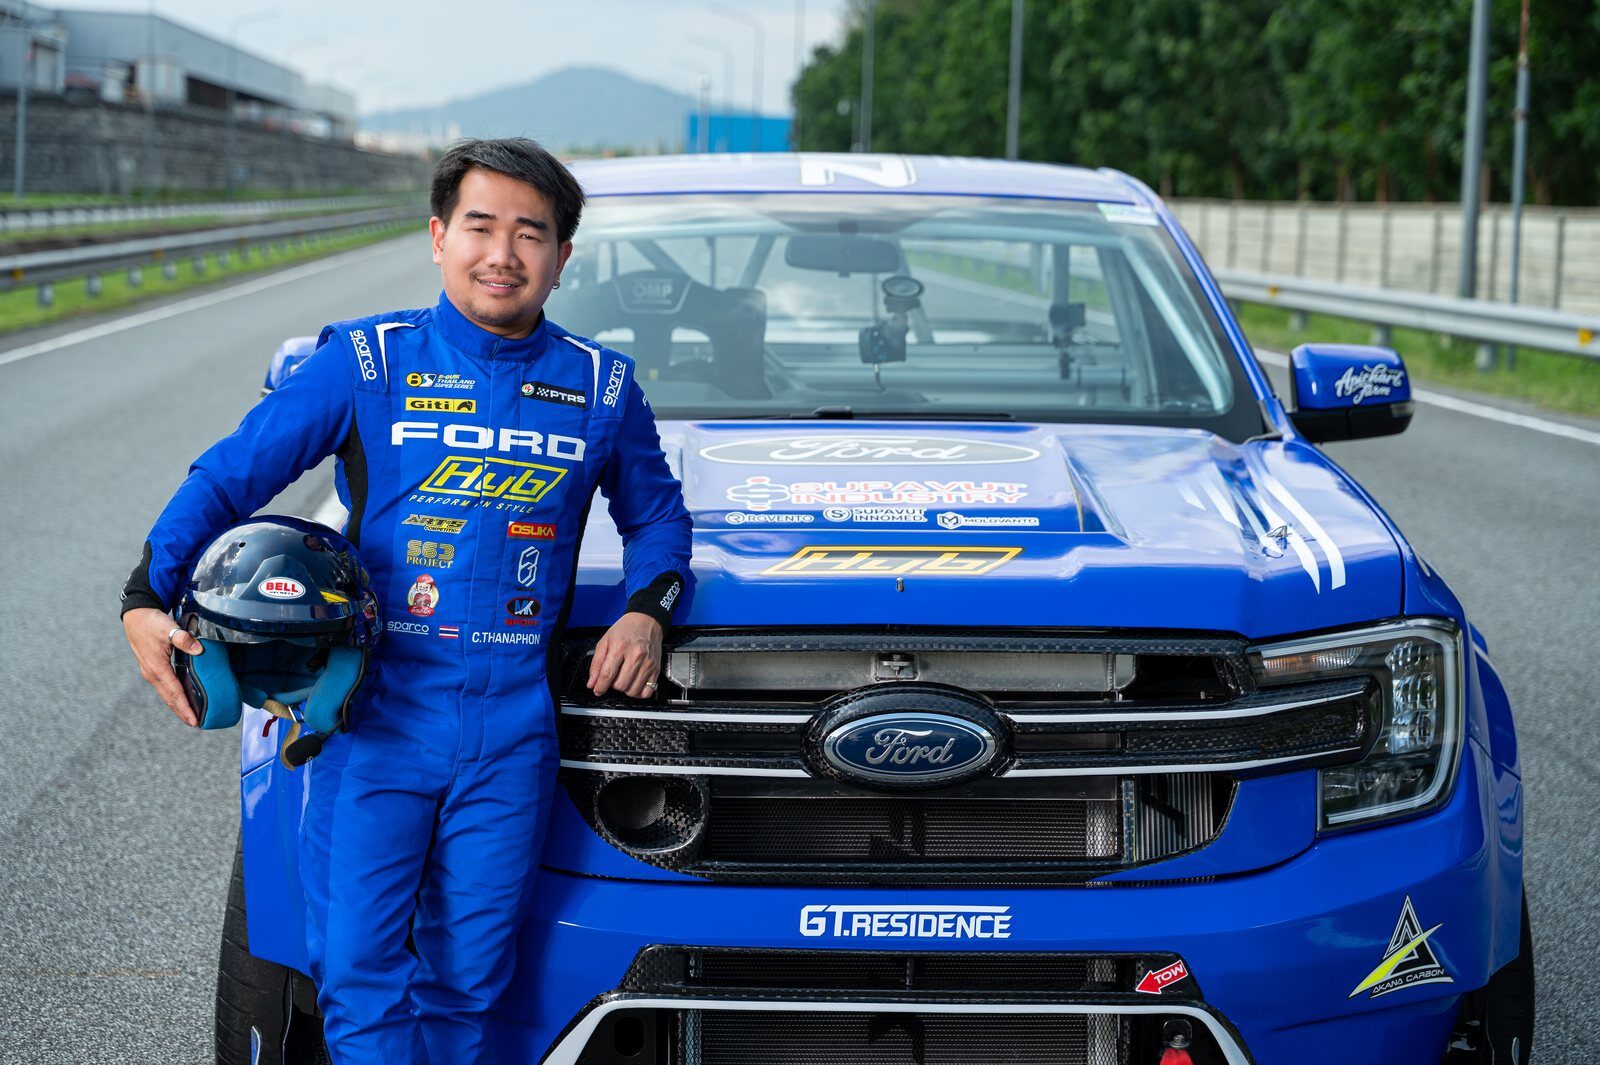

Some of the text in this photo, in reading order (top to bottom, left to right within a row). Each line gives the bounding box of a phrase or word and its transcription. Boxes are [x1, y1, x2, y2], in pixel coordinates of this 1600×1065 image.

[350, 329, 377, 381] sparco
[603, 360, 626, 407] sparco
[410, 400, 450, 410] Giti
[550, 390, 586, 404] PTRS
[391, 421, 586, 462] FORD
[768, 438, 969, 461] Ford
[432, 460, 546, 501] Hyb
[791, 481, 1028, 493] SUPAVUT
[409, 494, 471, 509] PERFORM
[497, 503, 534, 514] STYLE
[791, 492, 1028, 504] INDUSTRY
[747, 514, 813, 523] ROVENTO
[511, 524, 554, 537] OSUKA
[407, 540, 454, 560] S63
[406, 556, 454, 568] PROJECT
[266, 582, 298, 592] BELL
[660, 582, 680, 611] sparco
[386, 620, 429, 635] sparco
[472, 631, 540, 645] C.THANAPHON
[865, 728, 955, 765] Ford
[1154, 964, 1185, 984] TOW
[1372, 968, 1445, 994] AKANA CARBON
